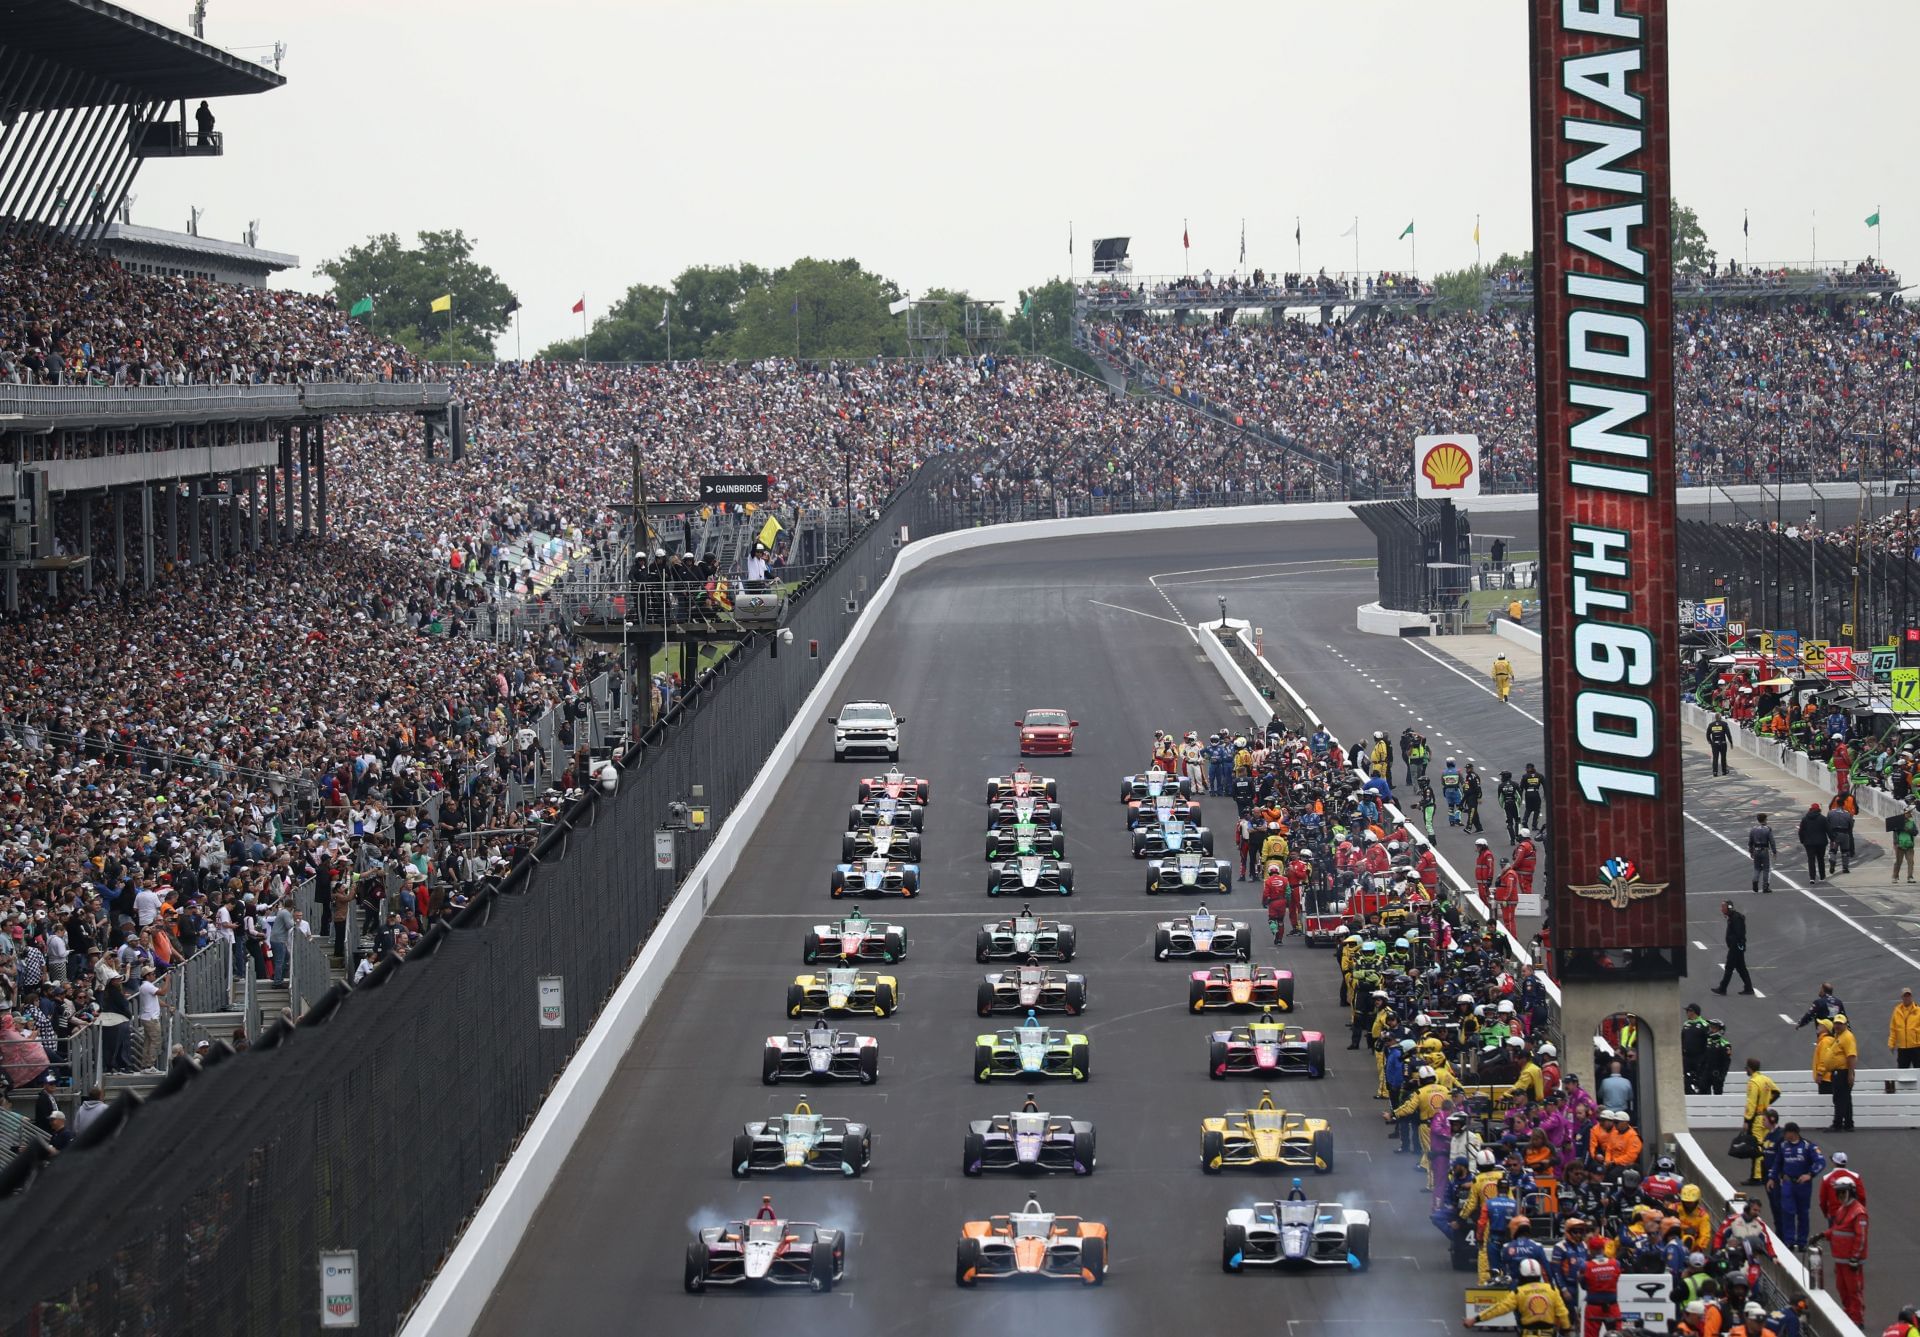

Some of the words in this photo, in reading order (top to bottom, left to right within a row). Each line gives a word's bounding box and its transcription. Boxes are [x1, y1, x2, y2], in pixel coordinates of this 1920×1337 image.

[715, 484, 763, 494] GAINBRIDGE
[1728, 623, 1743, 636] 90
[1805, 645, 1826, 660] 26
[1827, 651, 1849, 667] 27
[1572, 527, 1656, 802] 109TH
[1874, 655, 1894, 670] 45
[1896, 680, 1918, 699] 17
[1516, 1246, 1534, 1254] PNC
[1591, 1264, 1616, 1273] HONDA
